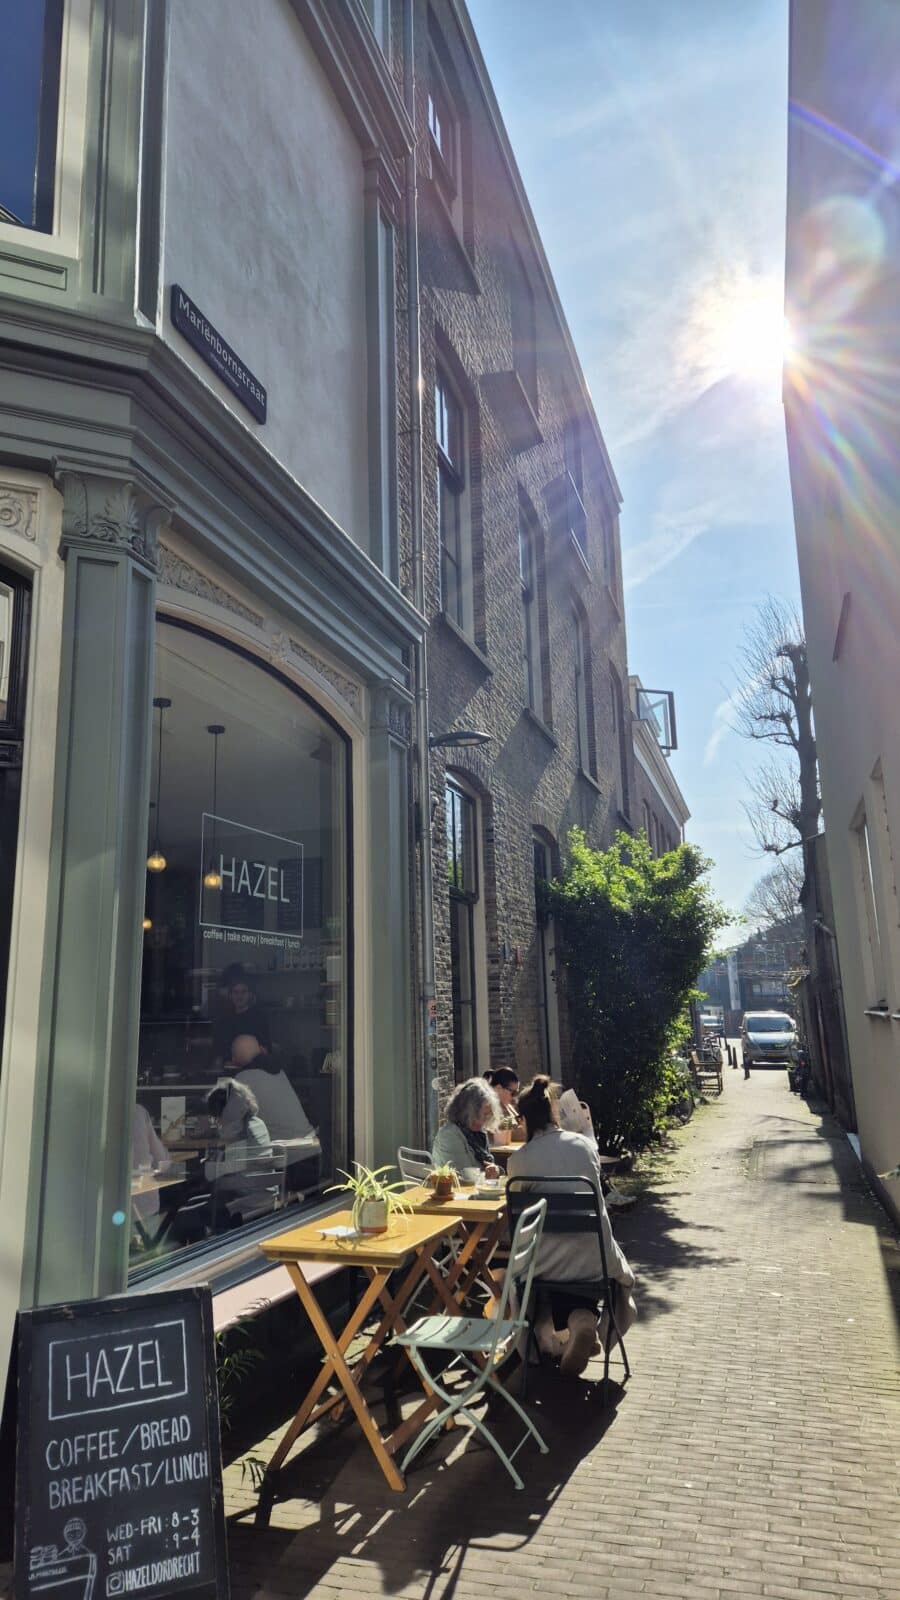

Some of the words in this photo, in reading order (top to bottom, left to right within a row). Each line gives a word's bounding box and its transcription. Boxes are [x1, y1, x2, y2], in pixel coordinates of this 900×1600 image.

[179, 293, 265, 405] Mariënbornstraat
[219, 853, 290, 903] HAZEL
[203, 928, 223, 940] coffee
[227, 931, 240, 942] take
[241, 934, 257, 945] away
[260, 934, 284, 947] breakfast
[65, 1339, 173, 1401] HAZEL
[107, 1543, 132, 1565] SAT
